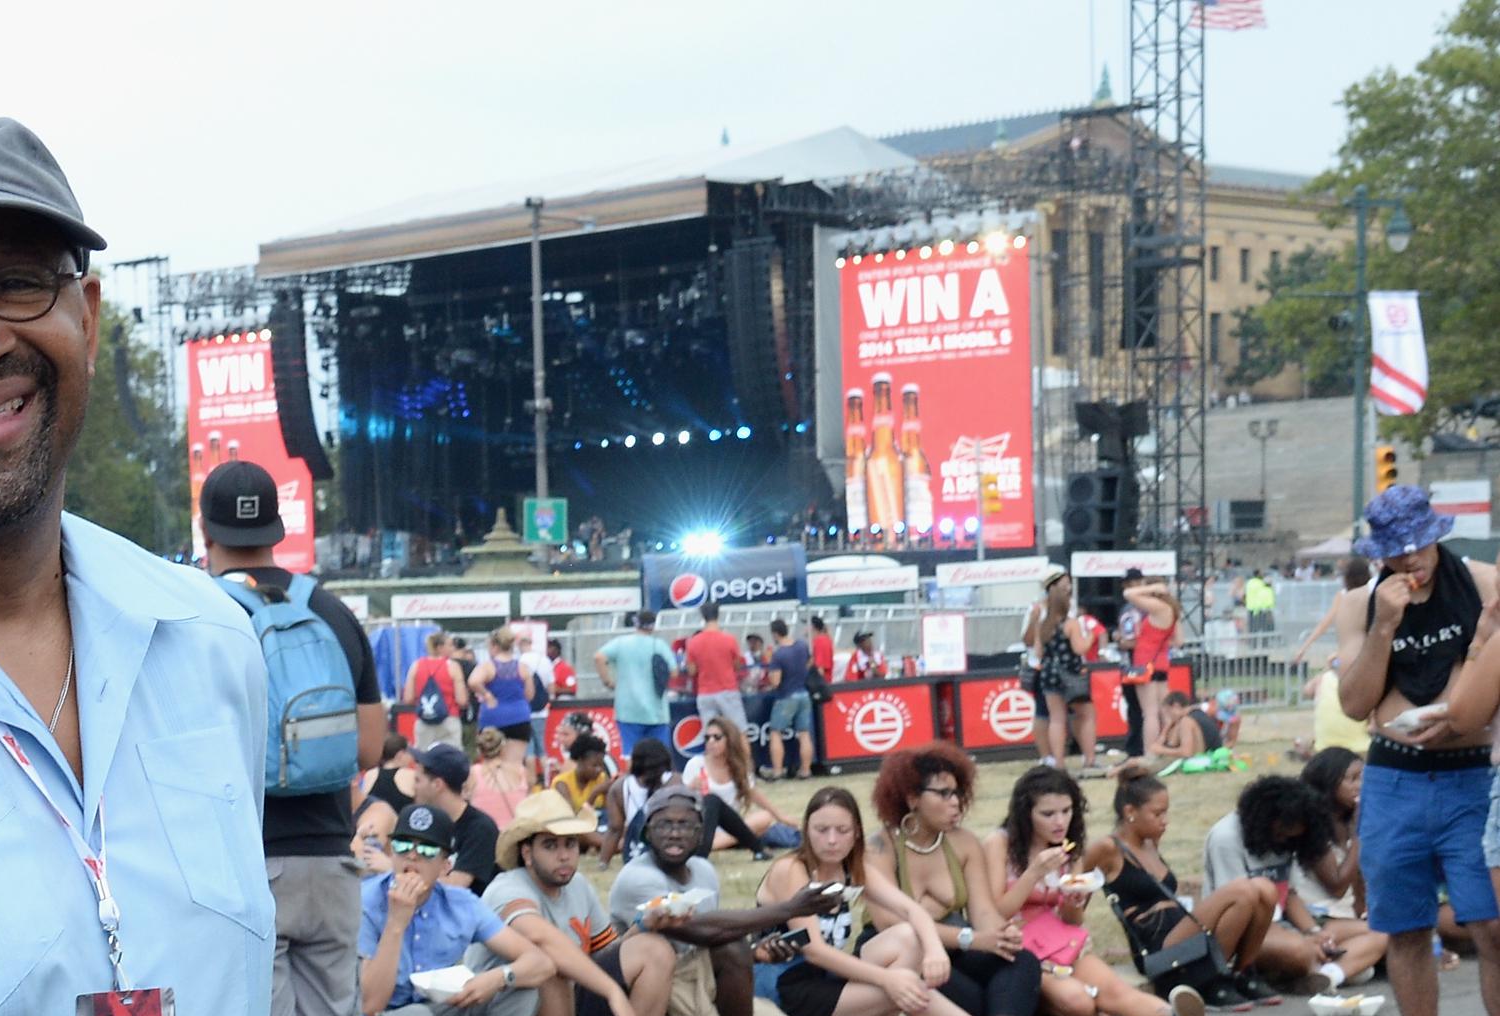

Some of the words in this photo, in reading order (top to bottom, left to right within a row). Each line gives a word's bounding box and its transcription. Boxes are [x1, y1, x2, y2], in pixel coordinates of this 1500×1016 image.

[858, 272, 960, 329] WIN
[969, 268, 1011, 318] A
[198, 352, 264, 397] WIN
[710, 571, 787, 603] pepsi
